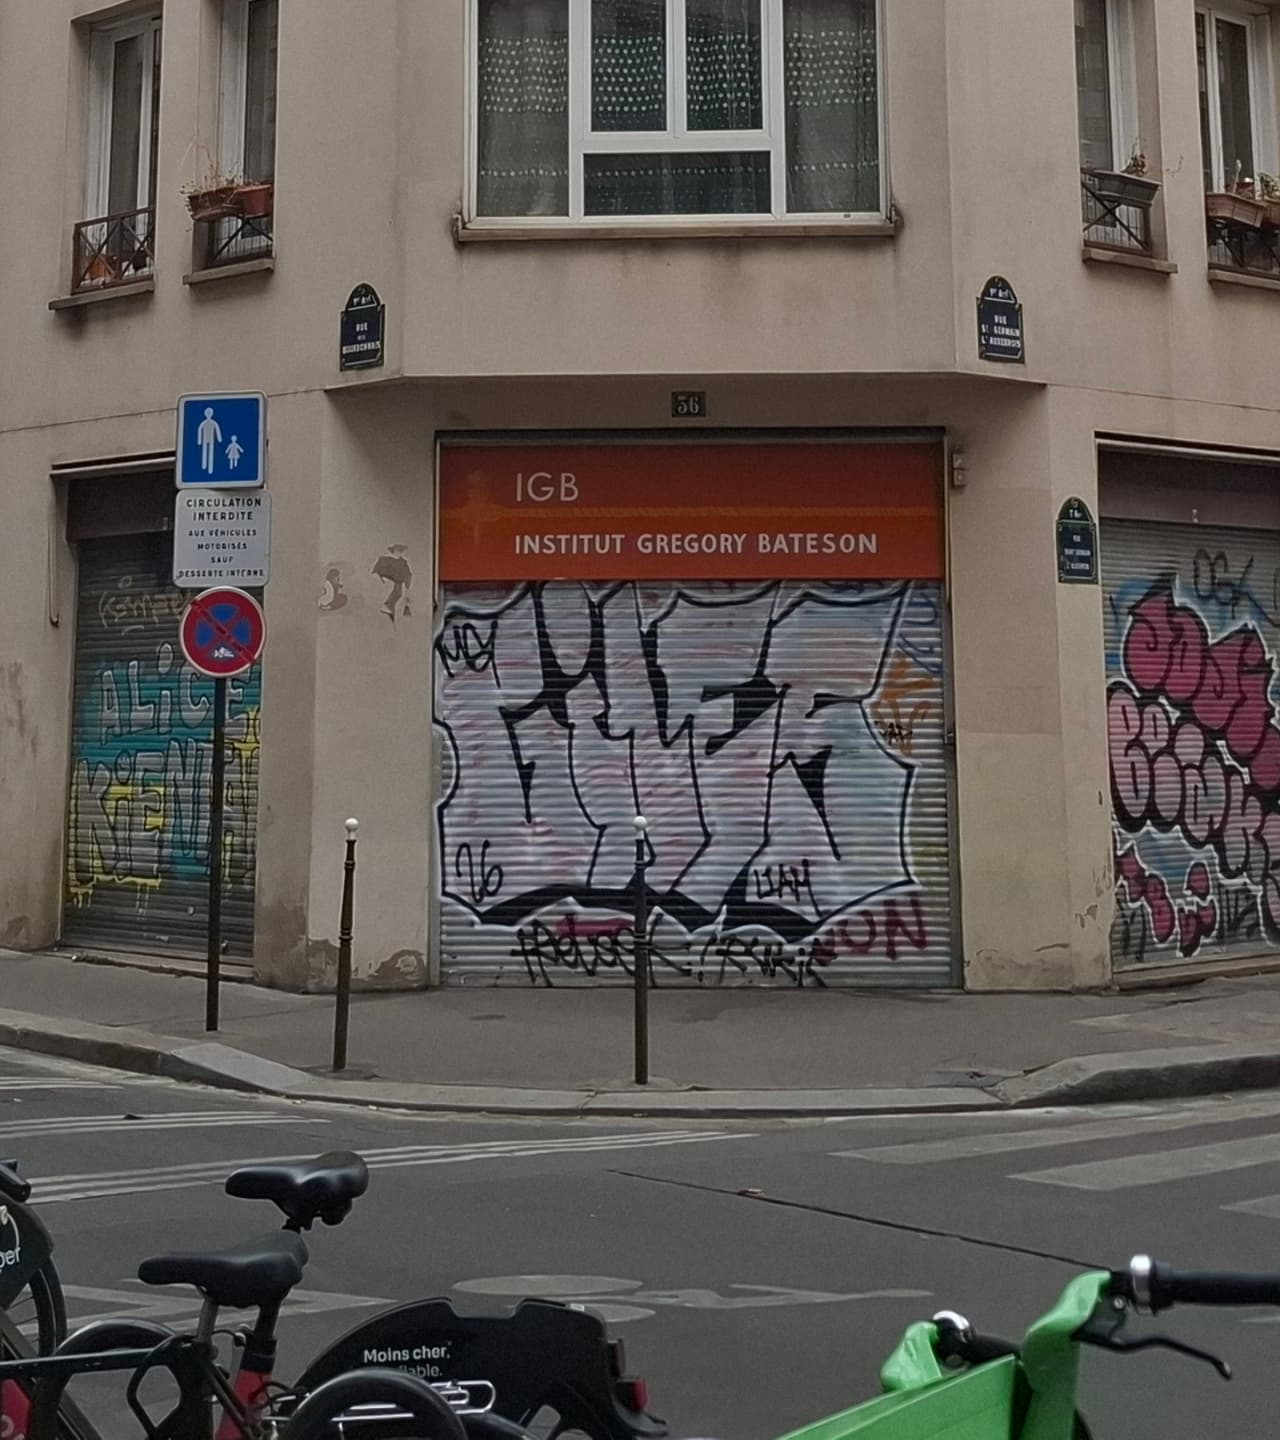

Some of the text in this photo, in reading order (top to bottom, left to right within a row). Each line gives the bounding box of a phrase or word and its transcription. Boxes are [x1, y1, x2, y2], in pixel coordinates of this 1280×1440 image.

[515, 471, 579, 502] IGB
[186, 497, 262, 509] CIRCULATION
[193, 511, 254, 521] INTERDITE
[515, 533, 877, 555] INSTITUT GREGORY BATESON
[211, 555, 234, 564] SAUF
[178, 569, 265, 578] DESSERTE INTERNE
[363, 1347, 410, 1364] Moins
